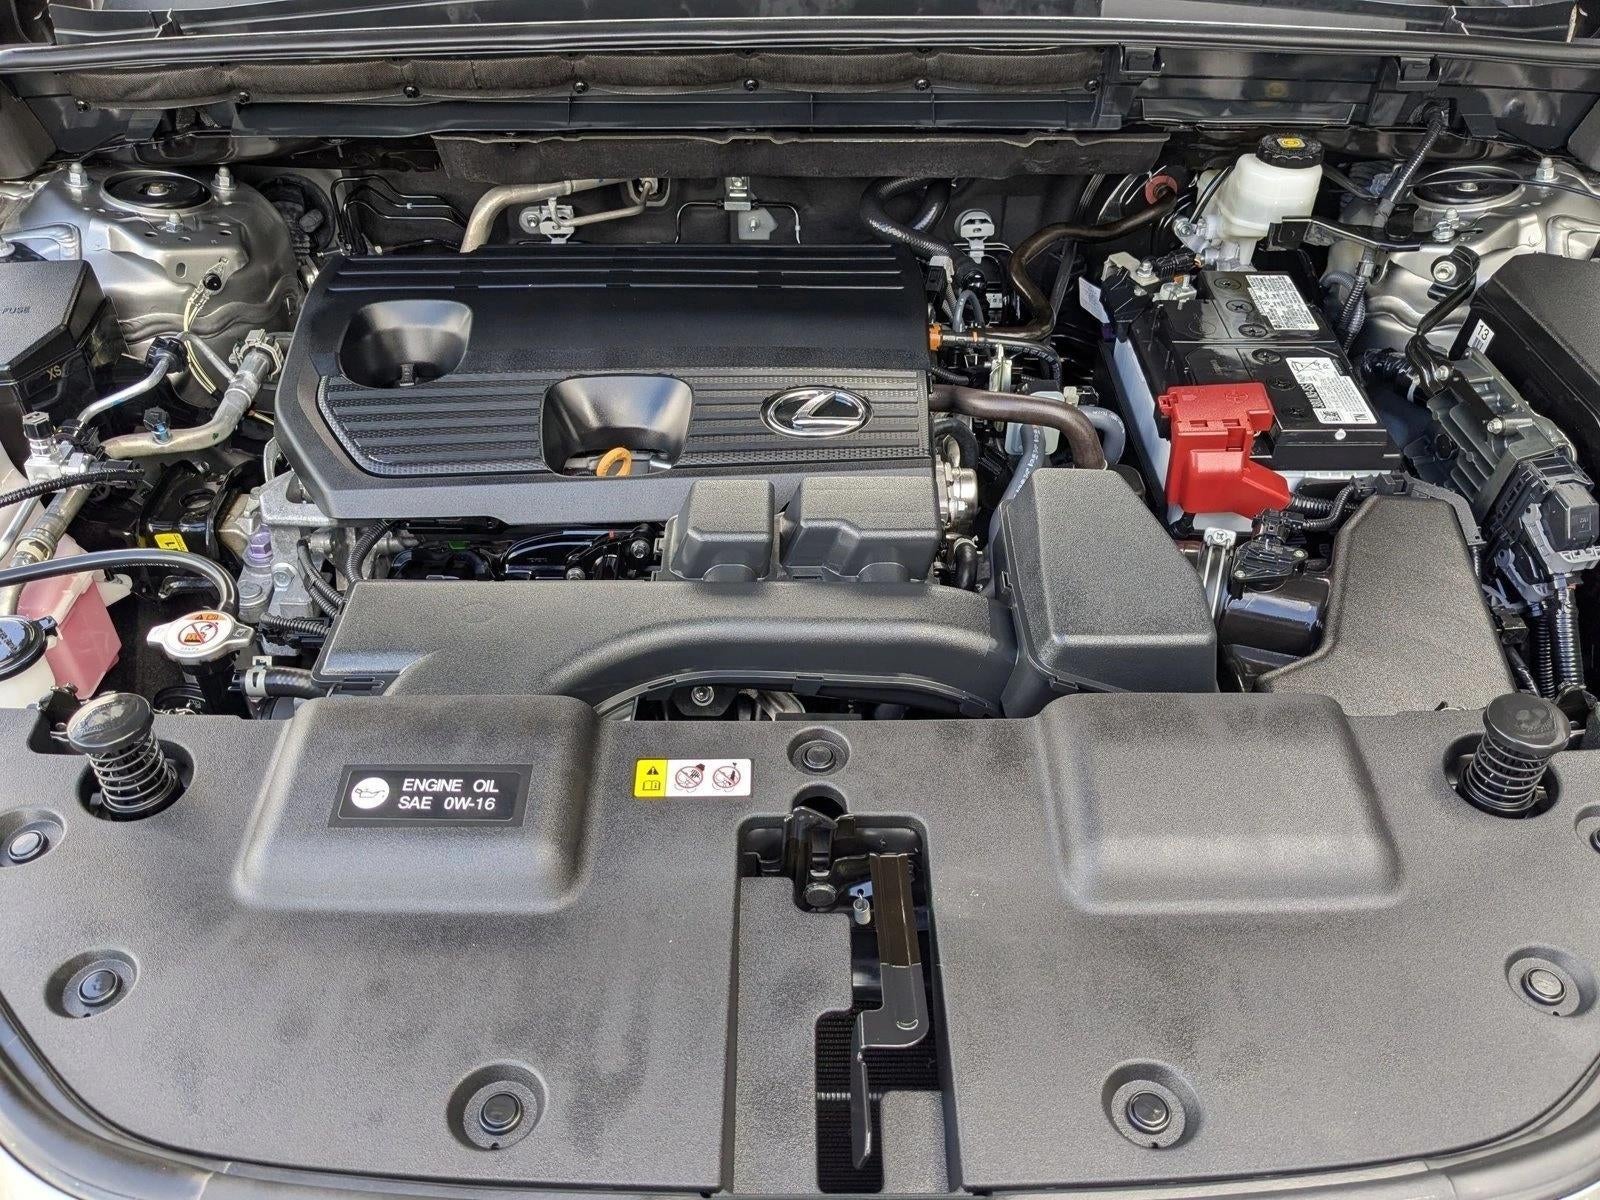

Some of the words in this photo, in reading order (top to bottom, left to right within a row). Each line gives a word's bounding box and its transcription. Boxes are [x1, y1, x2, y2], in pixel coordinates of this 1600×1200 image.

[1477, 324, 1490, 341] 13
[402, 778, 464, 792] ENGINE
[473, 779, 499, 793] OIL
[398, 797, 433, 810] SAE
[443, 797, 496, 811] 0W-16
